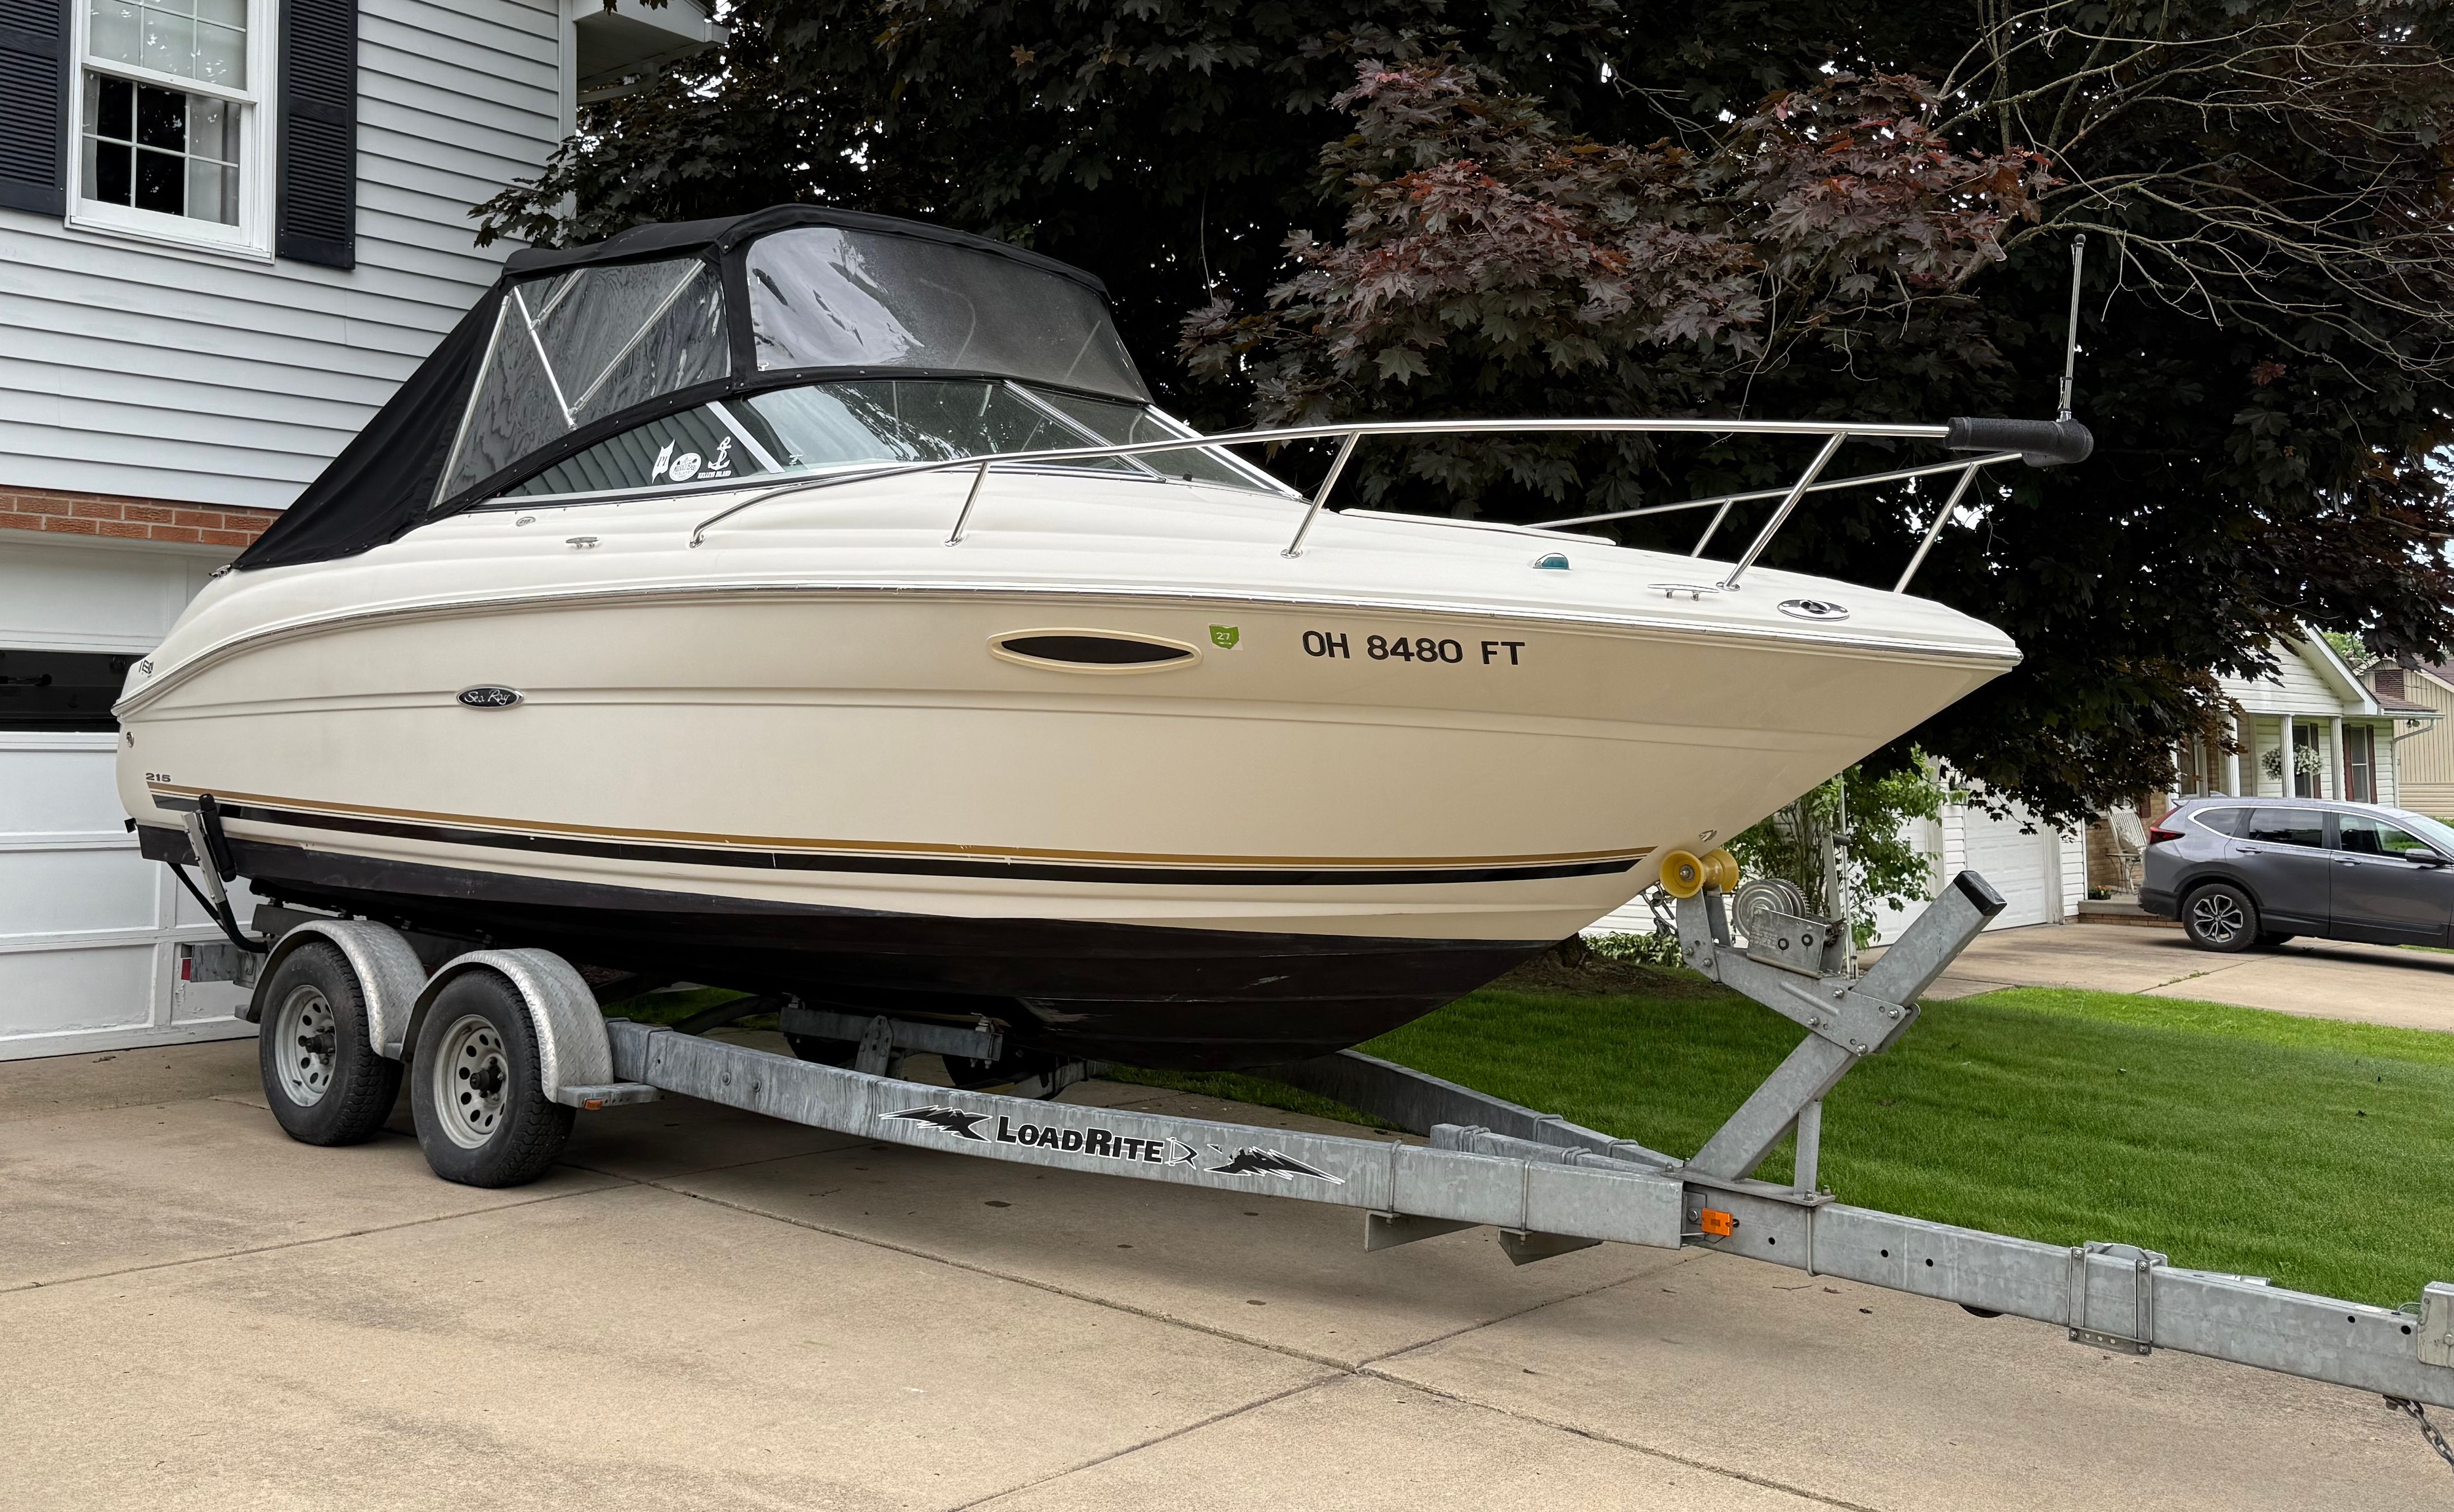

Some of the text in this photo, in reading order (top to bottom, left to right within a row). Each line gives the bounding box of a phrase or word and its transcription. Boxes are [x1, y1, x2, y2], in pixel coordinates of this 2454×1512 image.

[1302, 630, 1525, 665] OH 8480 FT
[464, 689, 511, 705] Sea Ray
[146, 773, 171, 782] 215
